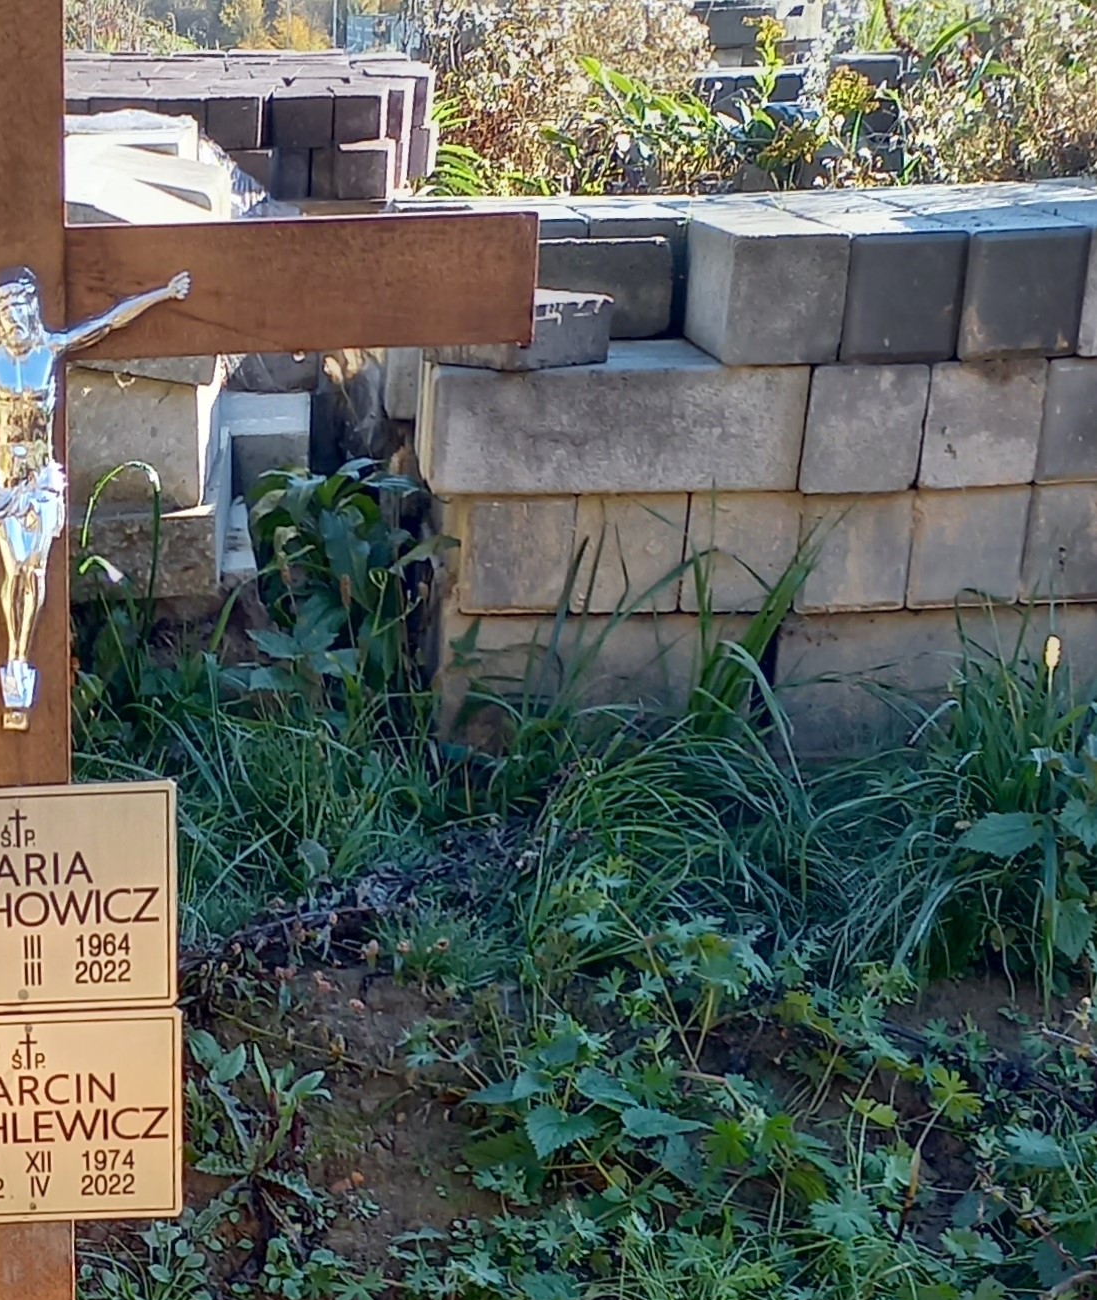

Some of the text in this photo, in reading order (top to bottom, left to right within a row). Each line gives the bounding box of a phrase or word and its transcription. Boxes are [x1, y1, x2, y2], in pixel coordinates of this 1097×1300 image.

[24, 935, 41, 959] III
[76, 933, 130, 958] 1964
[24, 962, 42, 986] III
[75, 959, 131, 984] 2022
[25, 1151, 52, 1173] XII
[81, 1149, 135, 1171] 1974
[31, 1175, 50, 1198] IV
[81, 1173, 135, 1196] 2022
